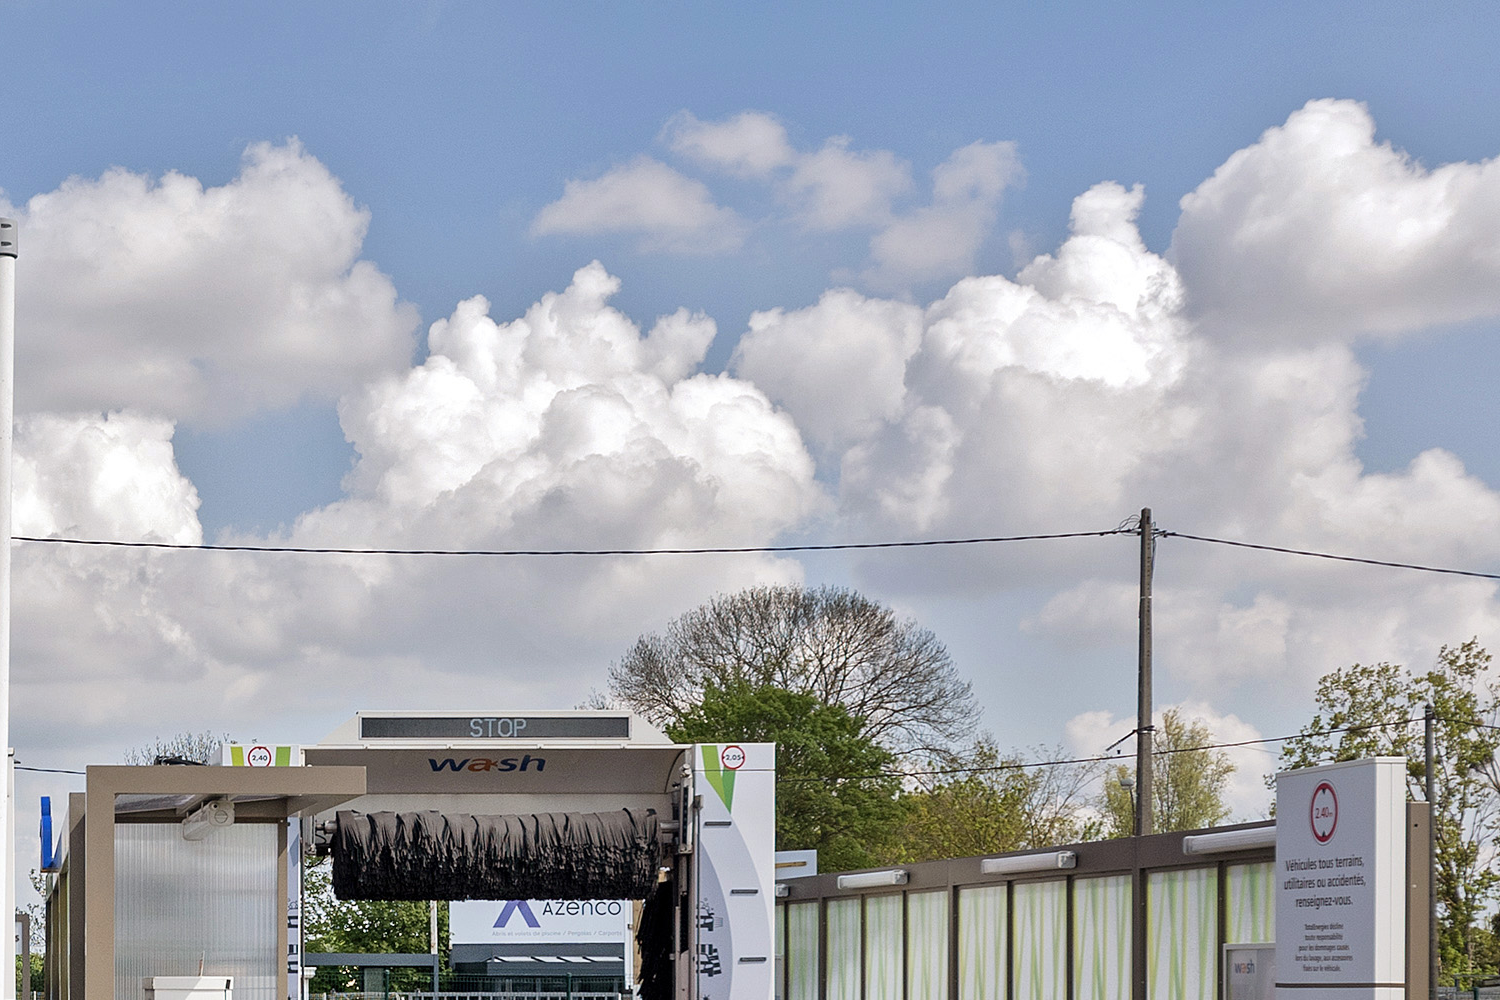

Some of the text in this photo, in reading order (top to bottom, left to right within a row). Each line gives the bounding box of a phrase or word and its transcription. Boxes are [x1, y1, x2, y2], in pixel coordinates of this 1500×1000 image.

[469, 718, 527, 738] STOP
[428, 754, 546, 772] wash
[1285, 858, 1317, 871] Véhicules
[1318, 860, 1334, 870] tous
[1284, 877, 1316, 890] utilitaires
[1317, 879, 1326, 888] ou
[1234, 959, 1255, 974] wash
